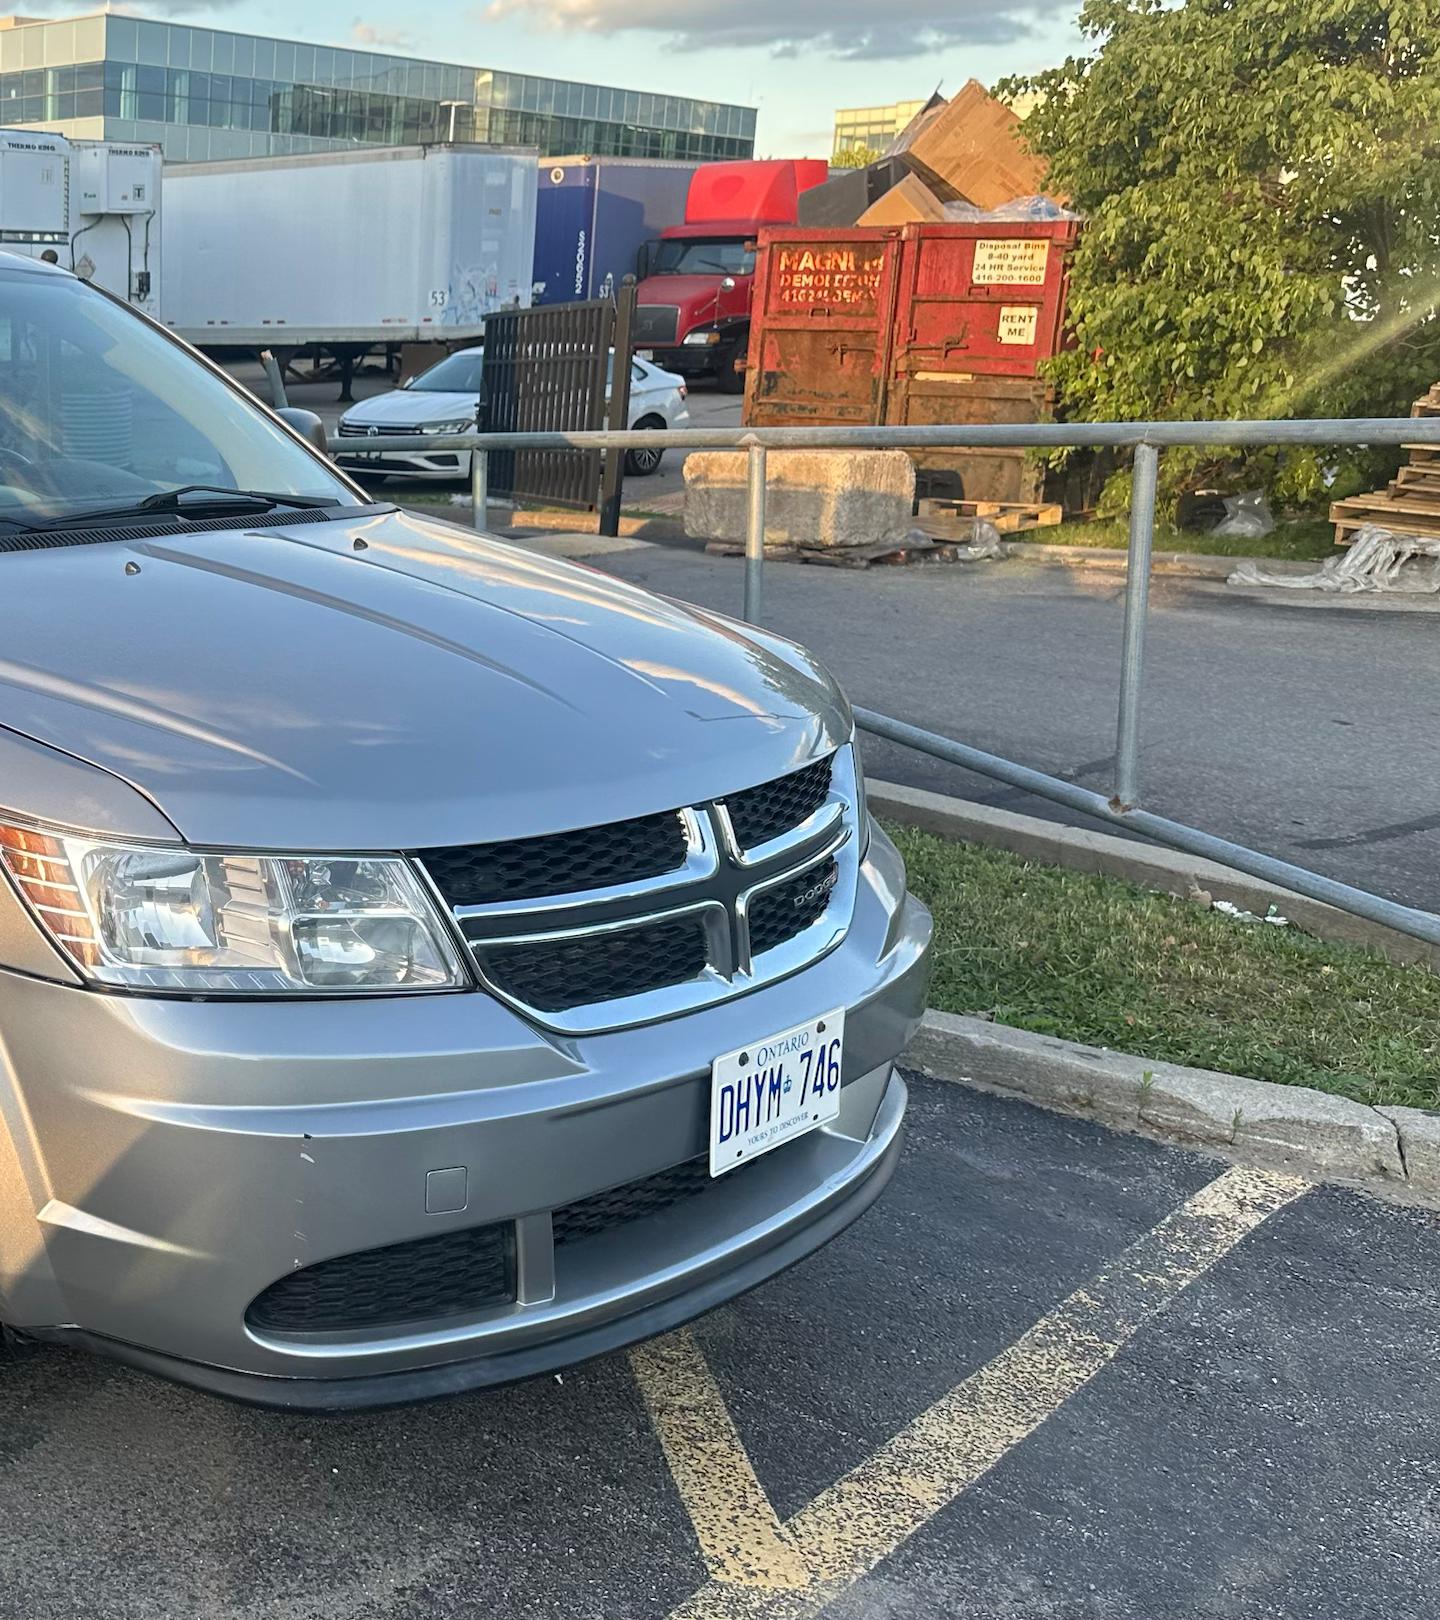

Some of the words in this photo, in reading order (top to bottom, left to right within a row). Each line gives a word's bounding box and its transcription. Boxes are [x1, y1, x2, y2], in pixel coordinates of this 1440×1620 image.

[7, 142, 37, 150] THERMO
[109, 149, 133, 157] THERMO
[979, 242, 1021, 251] Disposal
[1024, 242, 1046, 250] Bins
[987, 252, 1009, 261] 8-40
[1011, 253, 1034, 262] yard
[975, 263, 986, 271] 24
[989, 263, 1004, 271] HR
[1007, 263, 1045, 271] Service
[1001, 314, 1035, 324] RENT
[1007, 328, 1025, 337] ME
[757, 1031, 809, 1067] ONTARIO
[718, 1062, 784, 1145] DHYM
[798, 1037, 842, 1108] 746
[748, 1131, 768, 1146] YOURS
[769, 1125, 779, 1137] TO
[779, 1112, 810, 1132] DISCOVER
